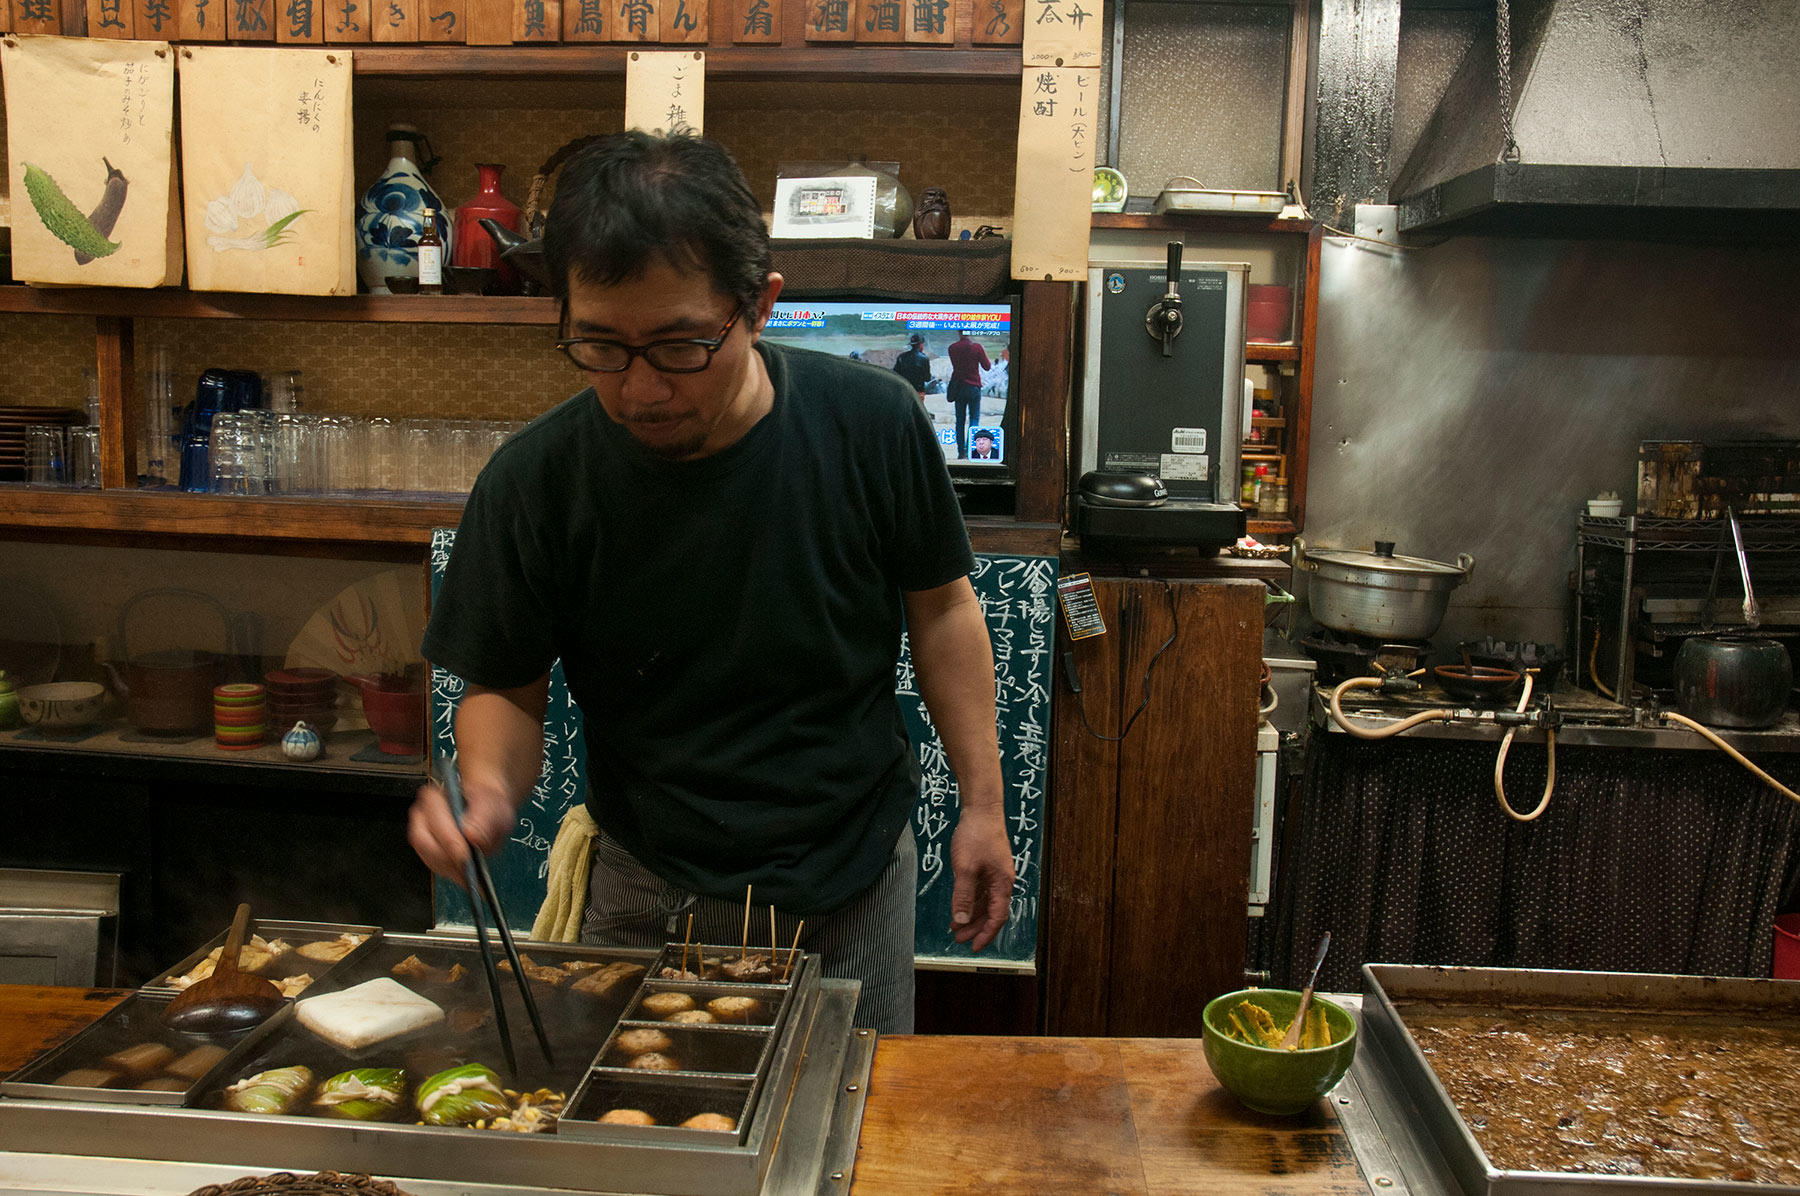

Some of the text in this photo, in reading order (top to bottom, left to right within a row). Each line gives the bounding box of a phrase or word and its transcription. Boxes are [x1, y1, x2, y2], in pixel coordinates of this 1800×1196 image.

[429, 10, 456, 29] つ
[312, 78, 325, 133] にんにくの
[1033, 71, 1058, 117] 焼酎
